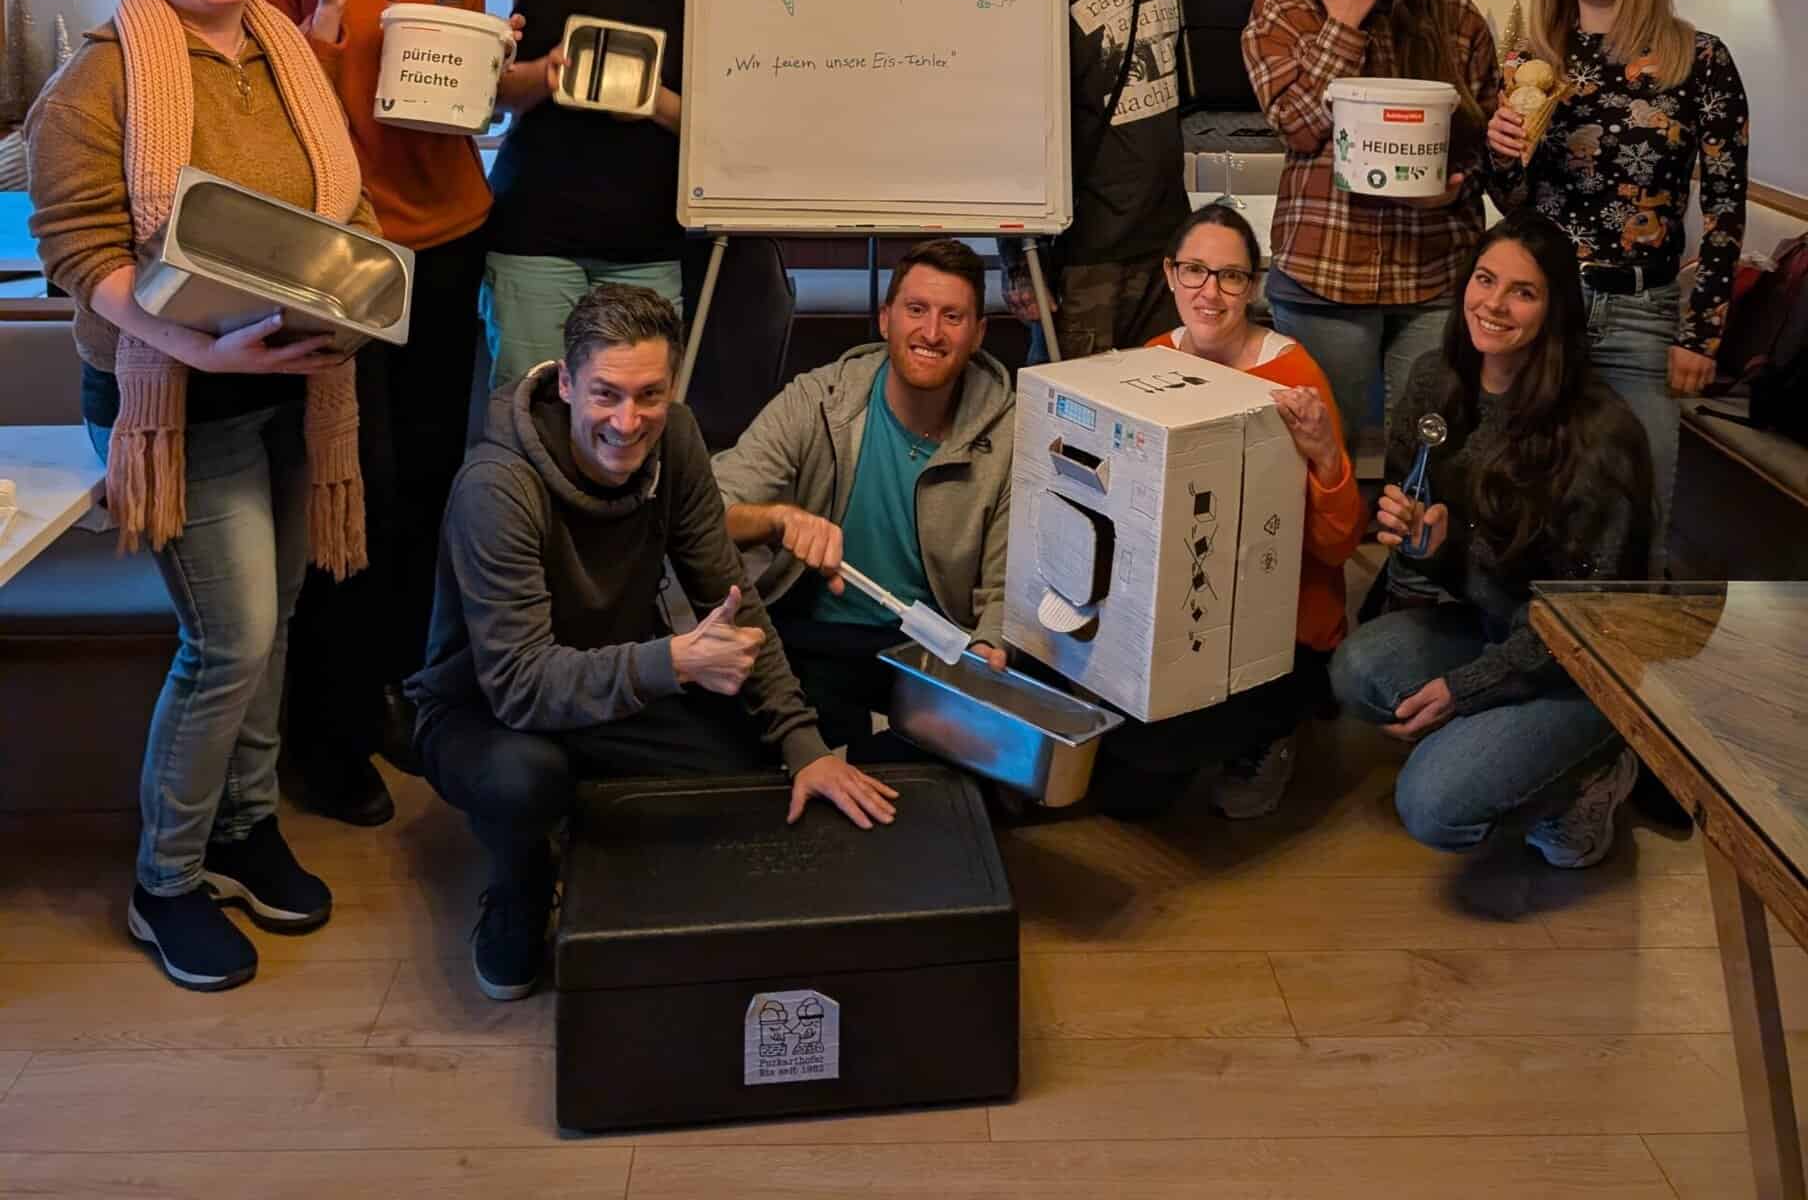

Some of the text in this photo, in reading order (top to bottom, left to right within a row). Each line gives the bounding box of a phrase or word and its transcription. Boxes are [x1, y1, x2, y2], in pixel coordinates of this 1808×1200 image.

[402, 47, 464, 67] pürierte
[825, 57, 867, 69] unsere
[399, 69, 459, 89] Früchte
